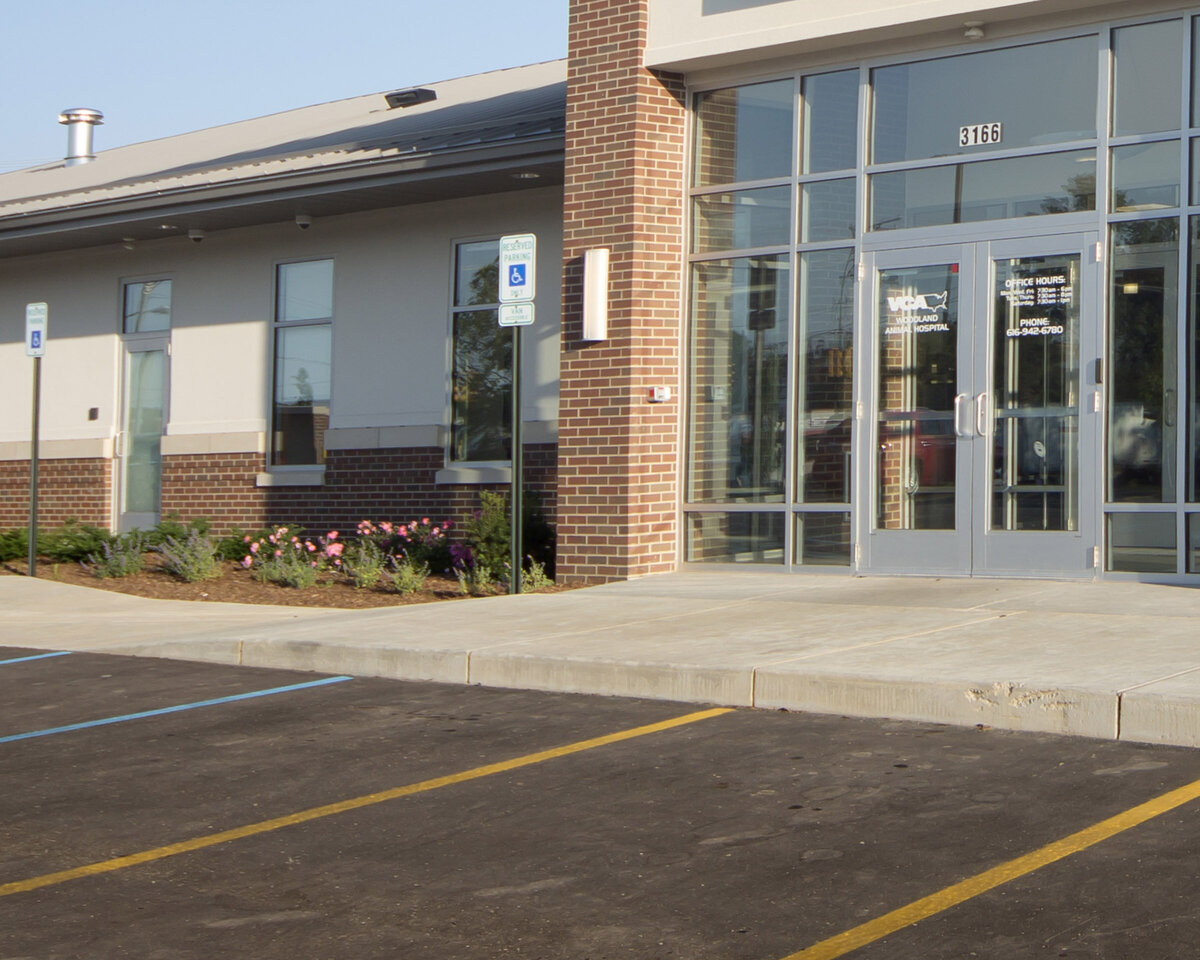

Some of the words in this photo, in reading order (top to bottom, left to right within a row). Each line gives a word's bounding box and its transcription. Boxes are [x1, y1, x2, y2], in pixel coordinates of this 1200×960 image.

[961, 123, 999, 145] 3166
[502, 241, 532, 251] RESERVED
[504, 252, 531, 262] PARKING
[1005, 278, 1034, 288] OFFICE
[1035, 275, 1066, 285] HOURS:
[887, 295, 928, 311] VCA
[896, 314, 938, 325] WOODLAND
[885, 325, 912, 335] ANIMAL
[916, 323, 950, 333] HOSPITAL
[1006, 325, 1064, 337] 616-942-6780
